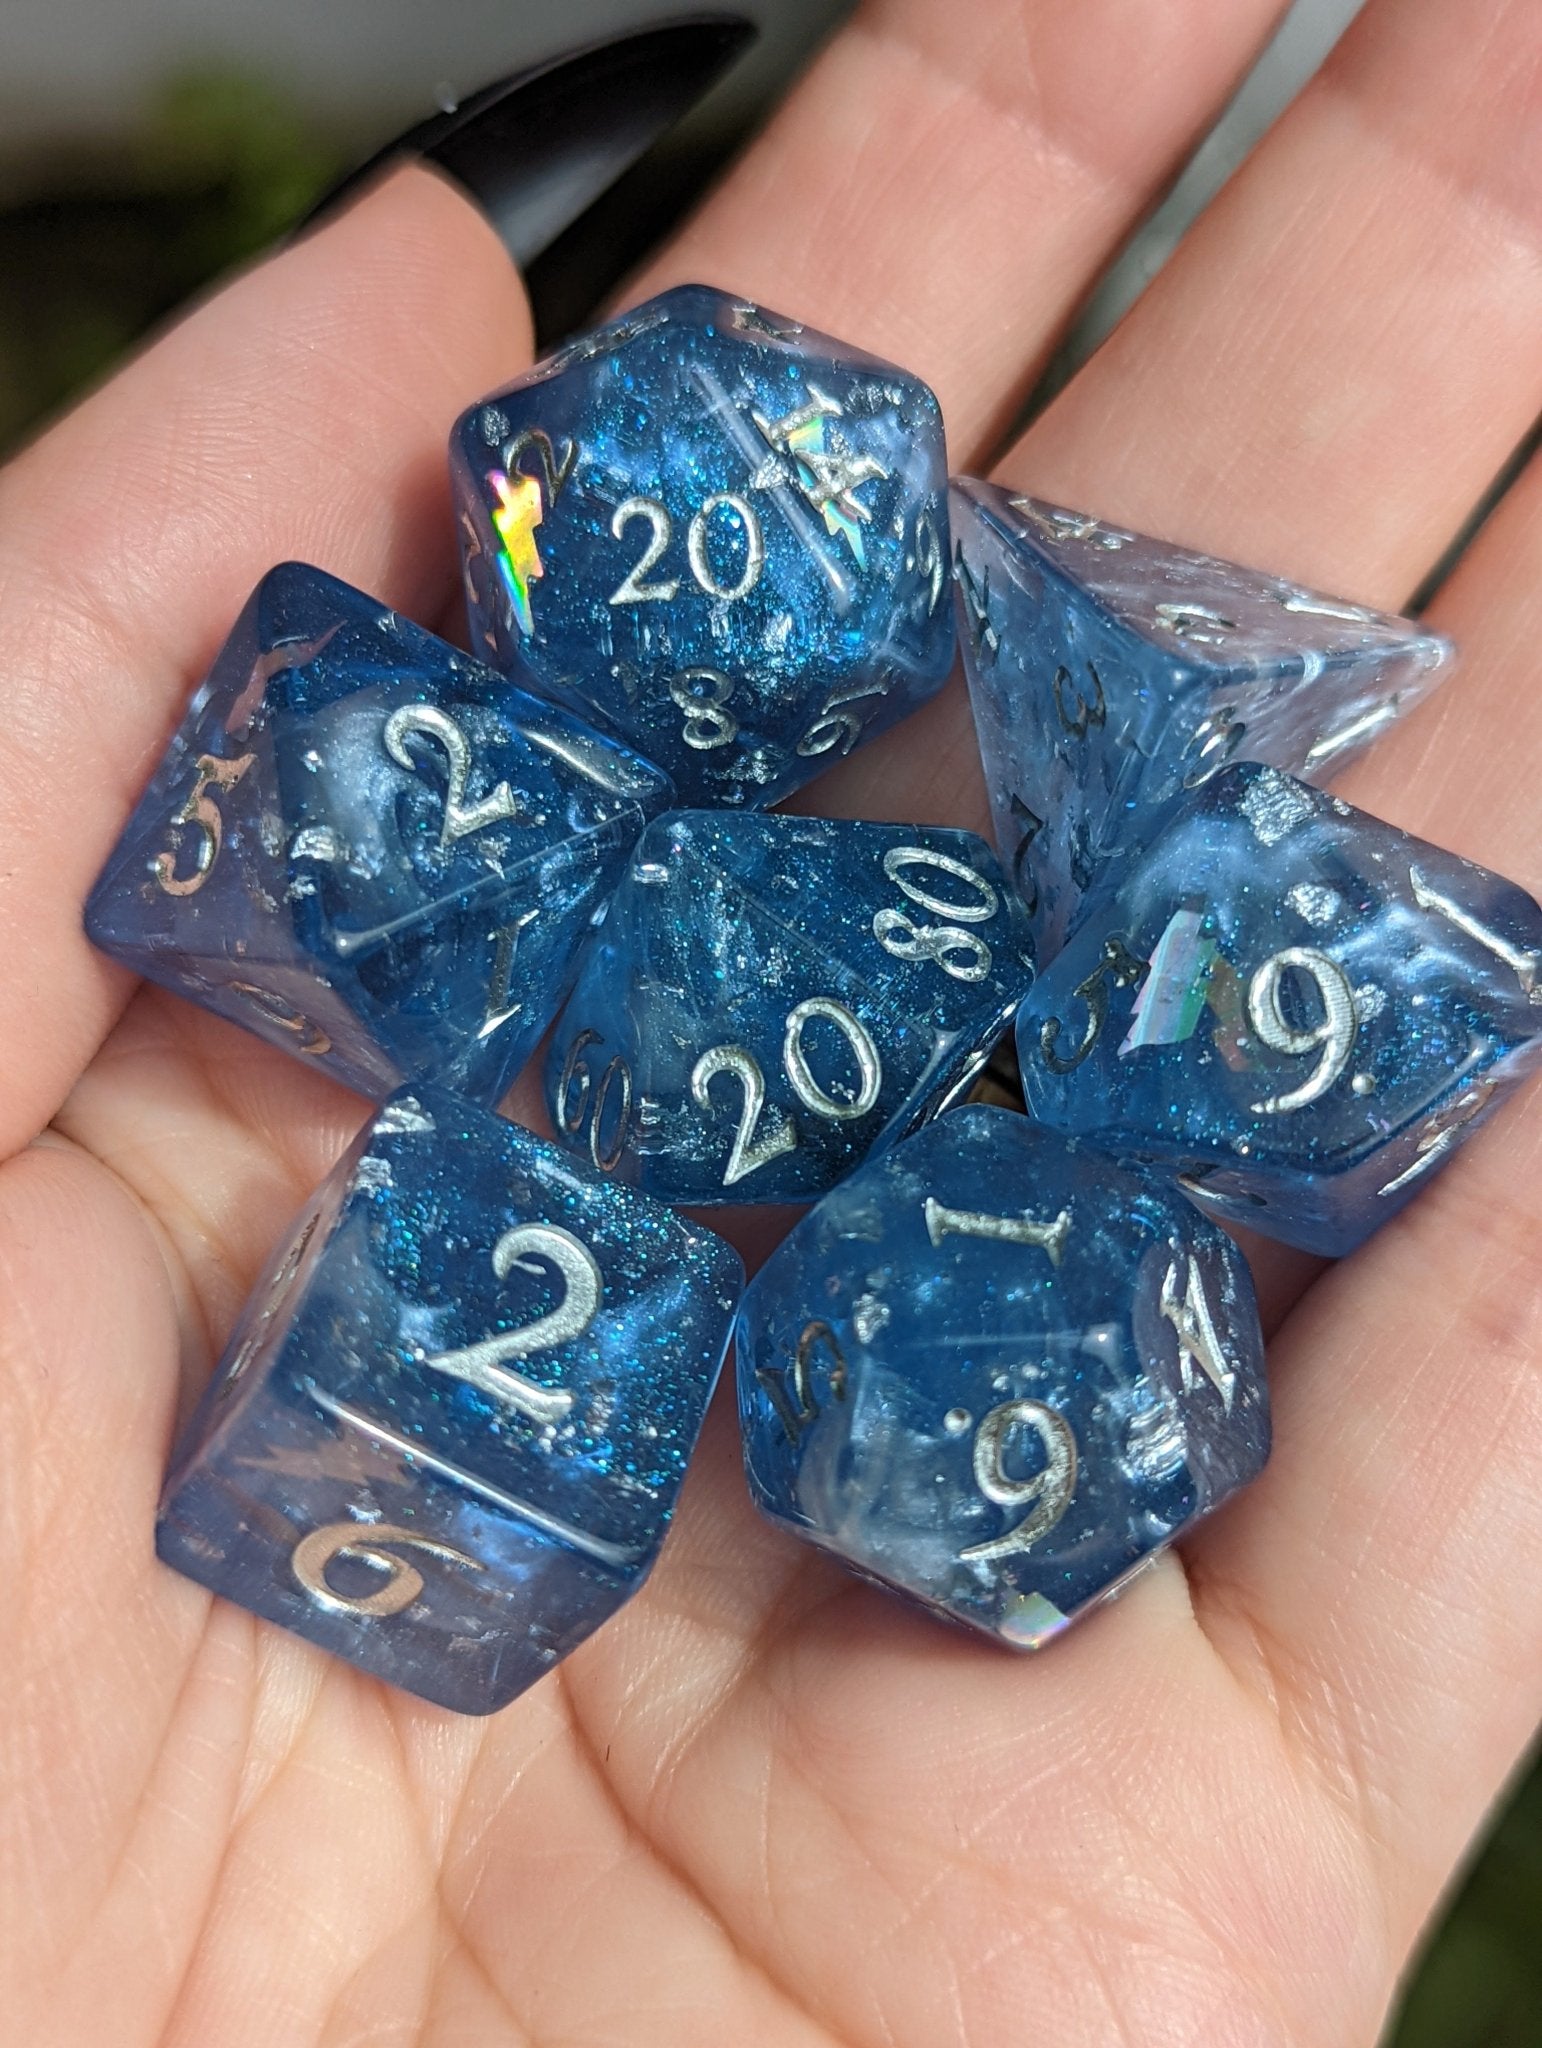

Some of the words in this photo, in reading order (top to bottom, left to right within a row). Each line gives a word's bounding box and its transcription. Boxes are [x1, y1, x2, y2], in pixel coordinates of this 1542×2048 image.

[502, 428, 580, 508] 2
[609, 491, 765, 605] 20
[669, 666, 740, 749] 8
[147, 753, 257, 897] 5
[384, 704, 517, 847] 2
[872, 846, 999, 983] 80
[1409, 865, 1541, 993] 1
[691, 996, 883, 1186] 20
[924, 1197, 1072, 1268] 1
[418, 1221, 604, 1424] 2
[291, 1521, 489, 1618] 6
